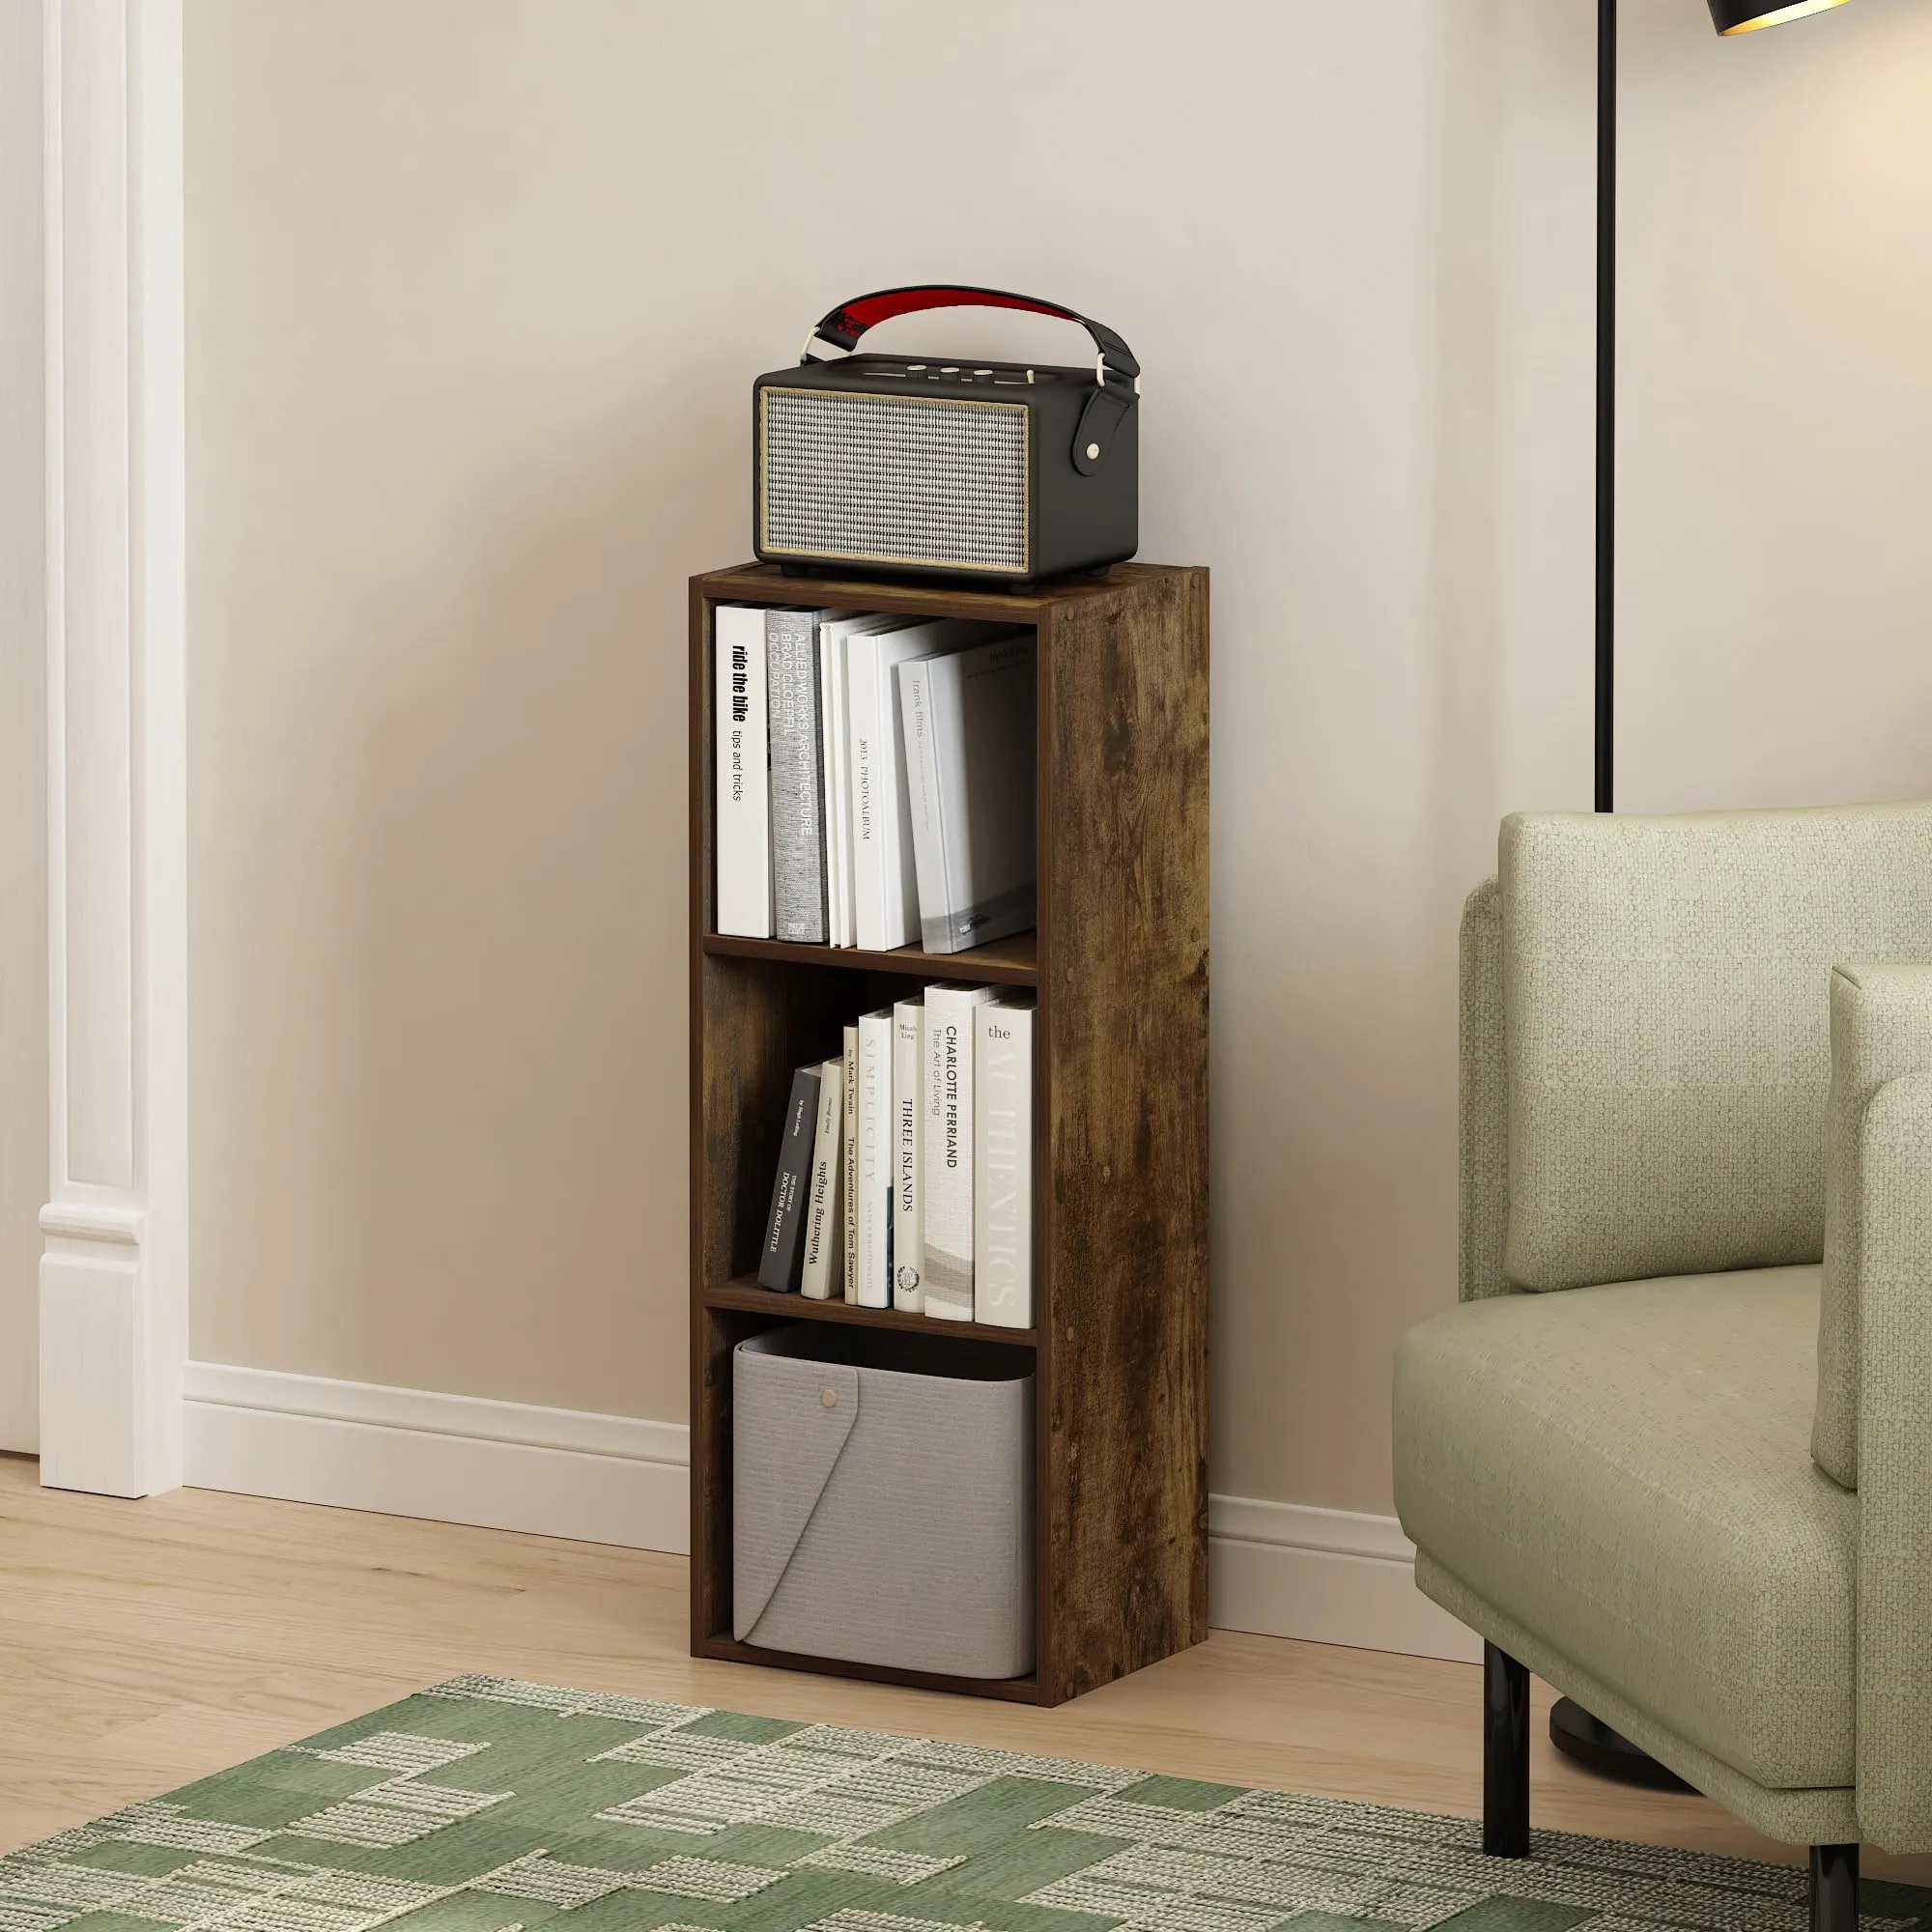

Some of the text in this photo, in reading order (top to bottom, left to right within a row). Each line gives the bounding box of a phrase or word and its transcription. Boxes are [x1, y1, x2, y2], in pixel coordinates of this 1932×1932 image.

[768, 632, 781, 721] OCCUPATION
[781, 633, 793, 670] BRAD
[912, 680, 923, 708] frank
[730, 645, 749, 802] ride the bike tips and tricks
[793, 633, 813, 837] ALLIED WORKS ARCHITECTURE
[915, 711, 925, 738] films
[859, 738, 871, 839] 2013 PHOTOALBUM
[932, 1029, 942, 1116] The Art of Living
[987, 1025, 1011, 1039] the
[866, 1038, 876, 1183] SIMPLICITY
[946, 1026, 958, 1169] CHARLOTTE PERRIAND
[902, 1098, 913, 1212] THREE ISLANDS
[987, 1046, 1017, 1308] AUTHENTICS
[770, 1172, 790, 1253] DOCTOR DOLITTLE
[786, 1204, 792, 1212] OF
[809, 1161, 828, 1264] Wuthering Heights
[848, 1216, 855, 1227] of
[846, 1252, 856, 1290] Sawyer
